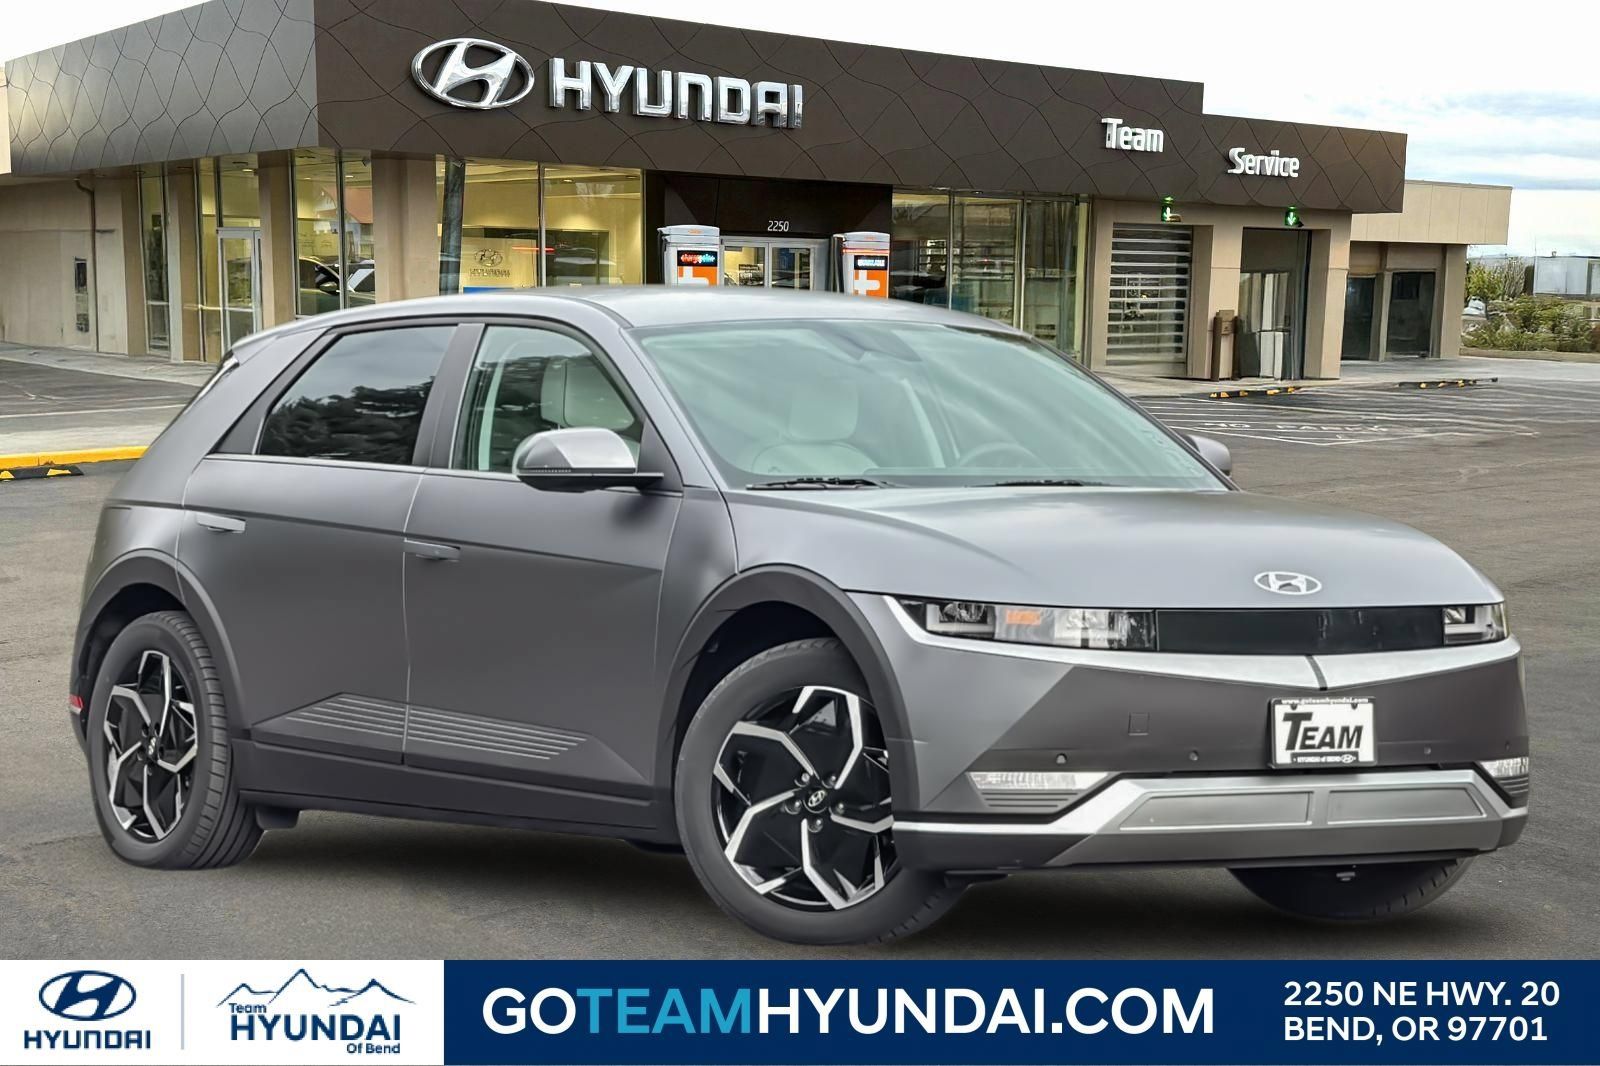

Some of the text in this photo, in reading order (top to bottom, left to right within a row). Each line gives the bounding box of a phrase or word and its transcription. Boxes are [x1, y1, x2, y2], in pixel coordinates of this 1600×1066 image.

[549, 57, 803, 129] HYUNDAI
[1101, 117, 1165, 152] Team
[1227, 147, 1300, 178] Service
[767, 220, 790, 232] 2250
[1282, 712, 1364, 751] TEAM
